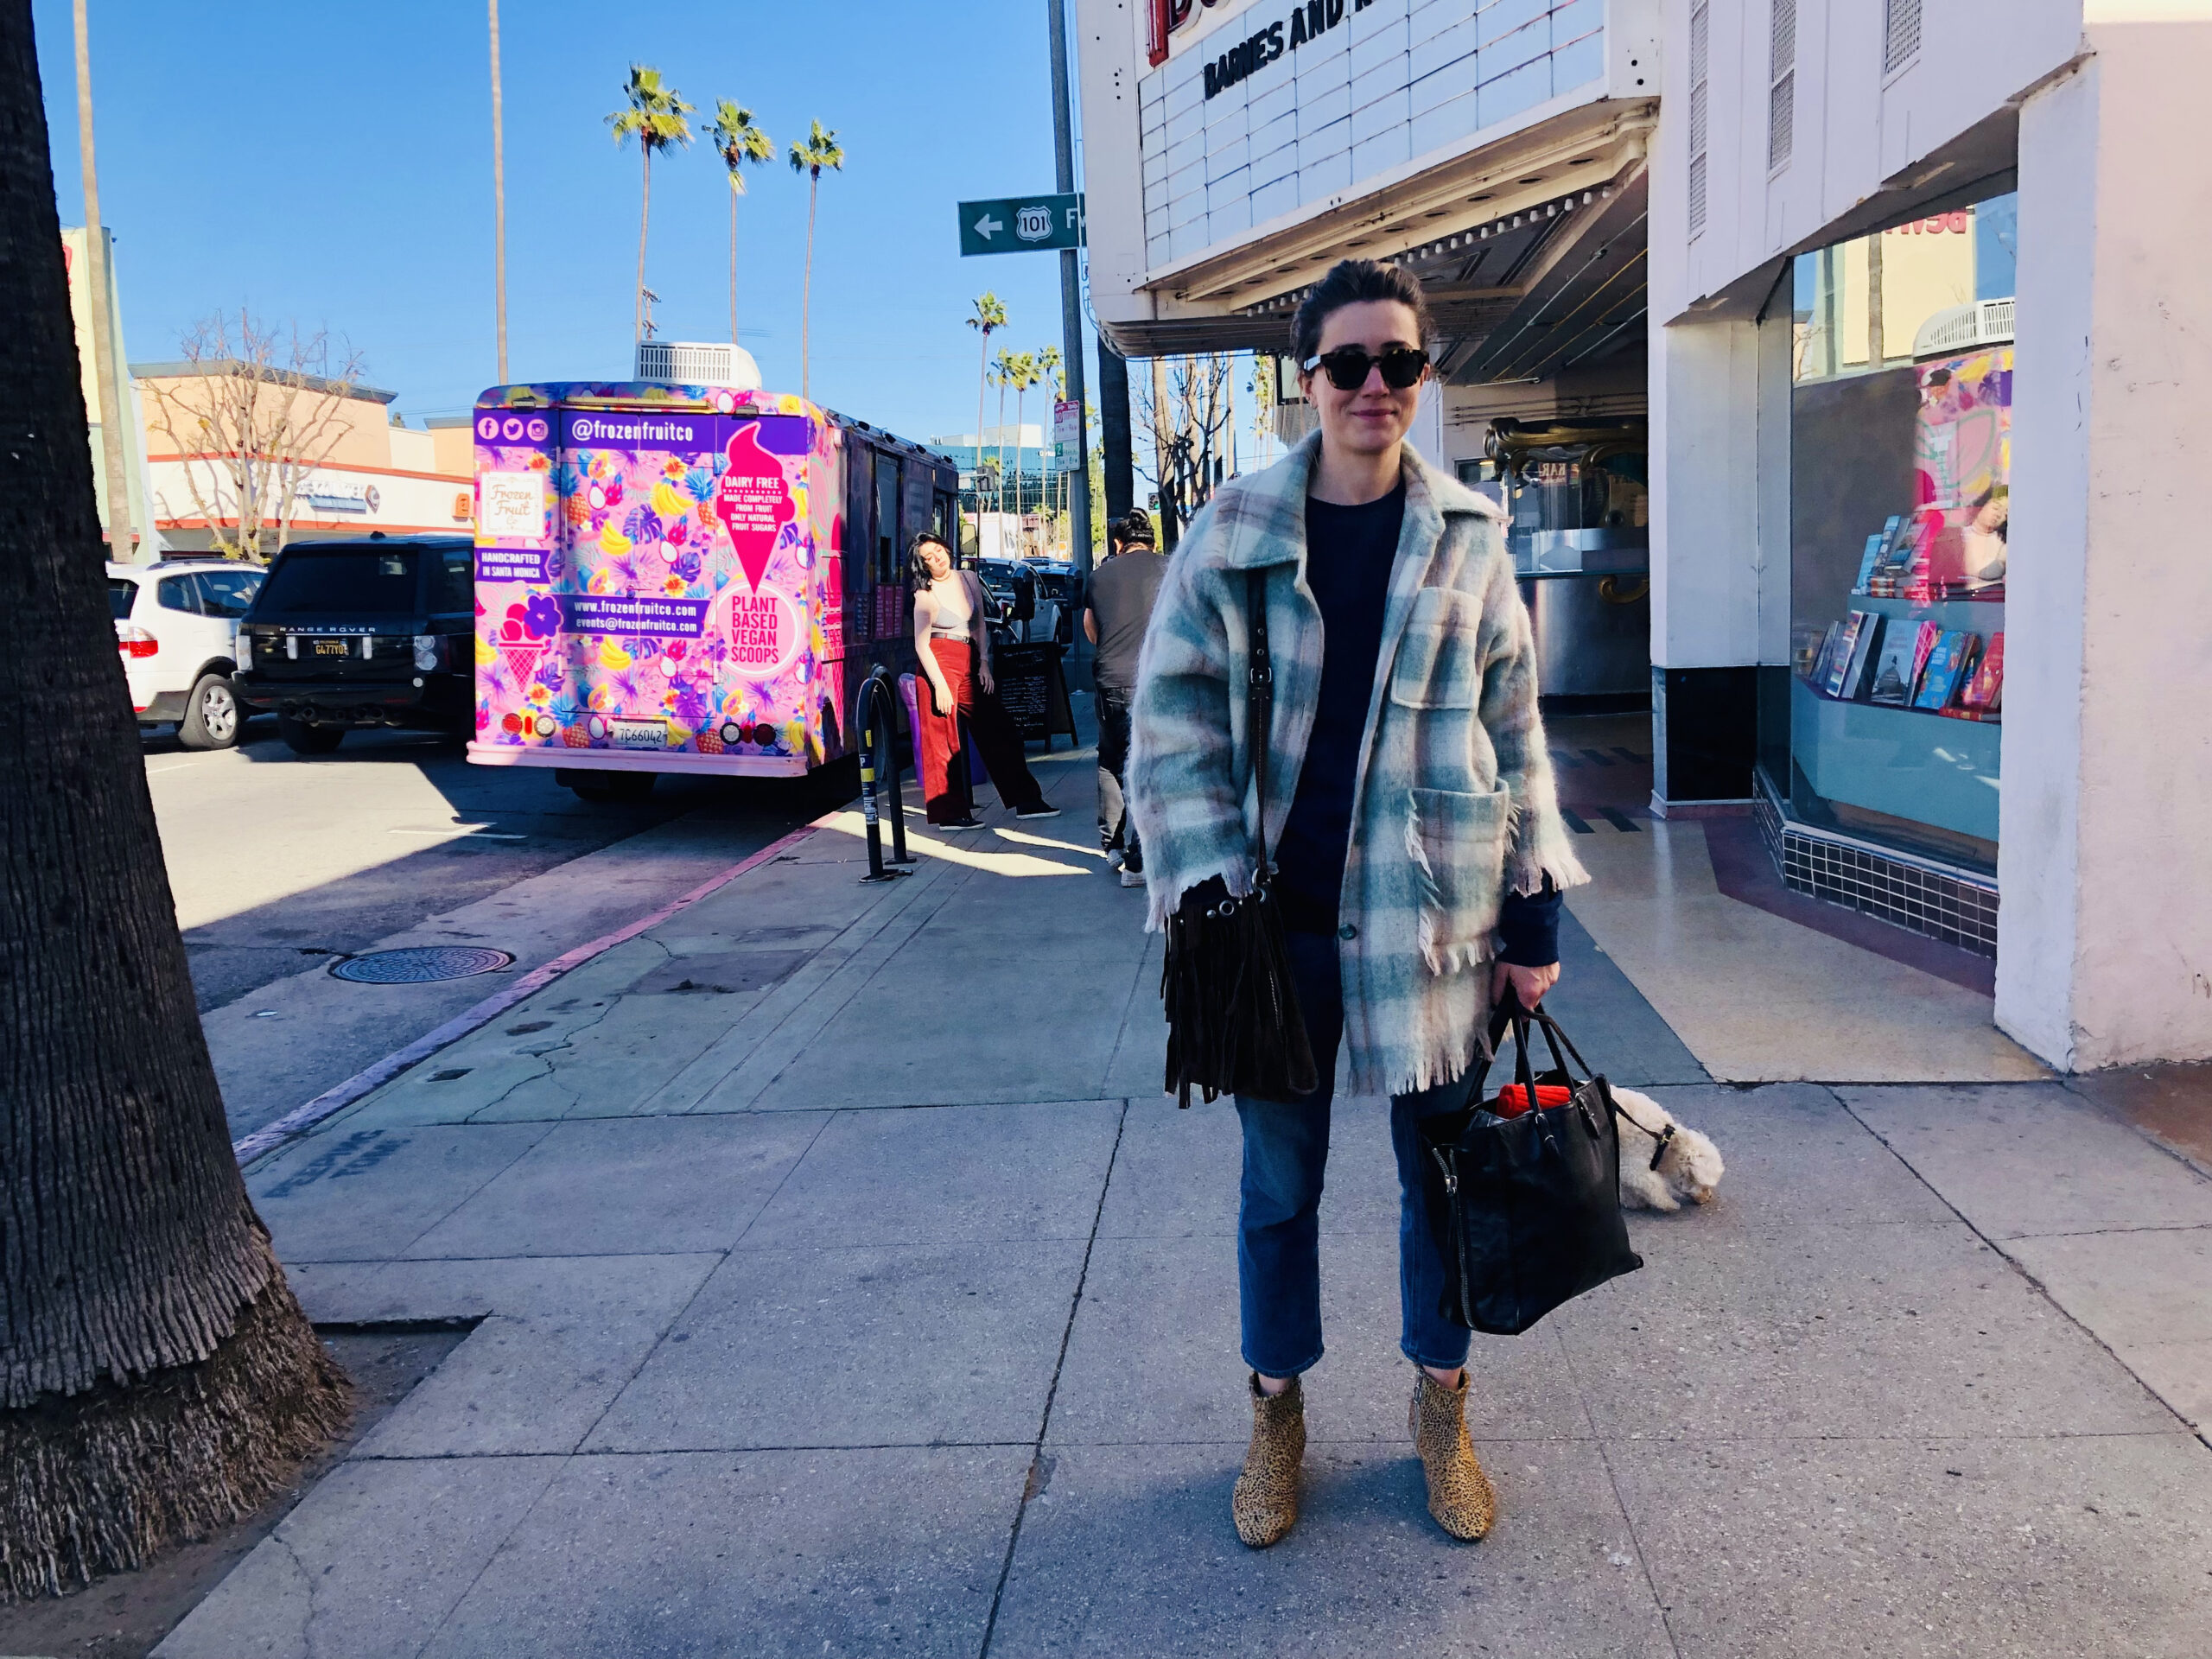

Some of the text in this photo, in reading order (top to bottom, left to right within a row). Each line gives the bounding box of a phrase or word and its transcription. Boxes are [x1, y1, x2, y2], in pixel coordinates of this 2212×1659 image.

[1205, 21, 1284, 100] BARNES
[1289, 0, 1345, 50] AND
[1022, 216, 1046, 232] 101
[572, 419, 693, 442] @frozenfruitco
[725, 476, 779, 489] DAIRY FREE
[491, 484, 533, 500] Frozen
[723, 494, 783, 504] MADE COMPLETELY
[494, 500, 531, 516] Fruit
[735, 504, 773, 513] FROM FRUIT
[730, 513, 776, 523] ONLY NATURAL
[752, 524, 777, 532] SUGARS
[481, 552, 541, 564] HANDCRAFTED
[482, 566, 541, 578] IN SANTA MONICA
[574, 600, 696, 617] www.frozenfruitco.com
[732, 595, 778, 613] PLANT
[575, 617, 697, 632] events@frozenfruitco.com
[732, 613, 778, 629] BASED
[731, 629, 777, 646] VEGAN
[731, 646, 779, 664] SCOOPS
[619, 728, 663, 744] 7C66042
